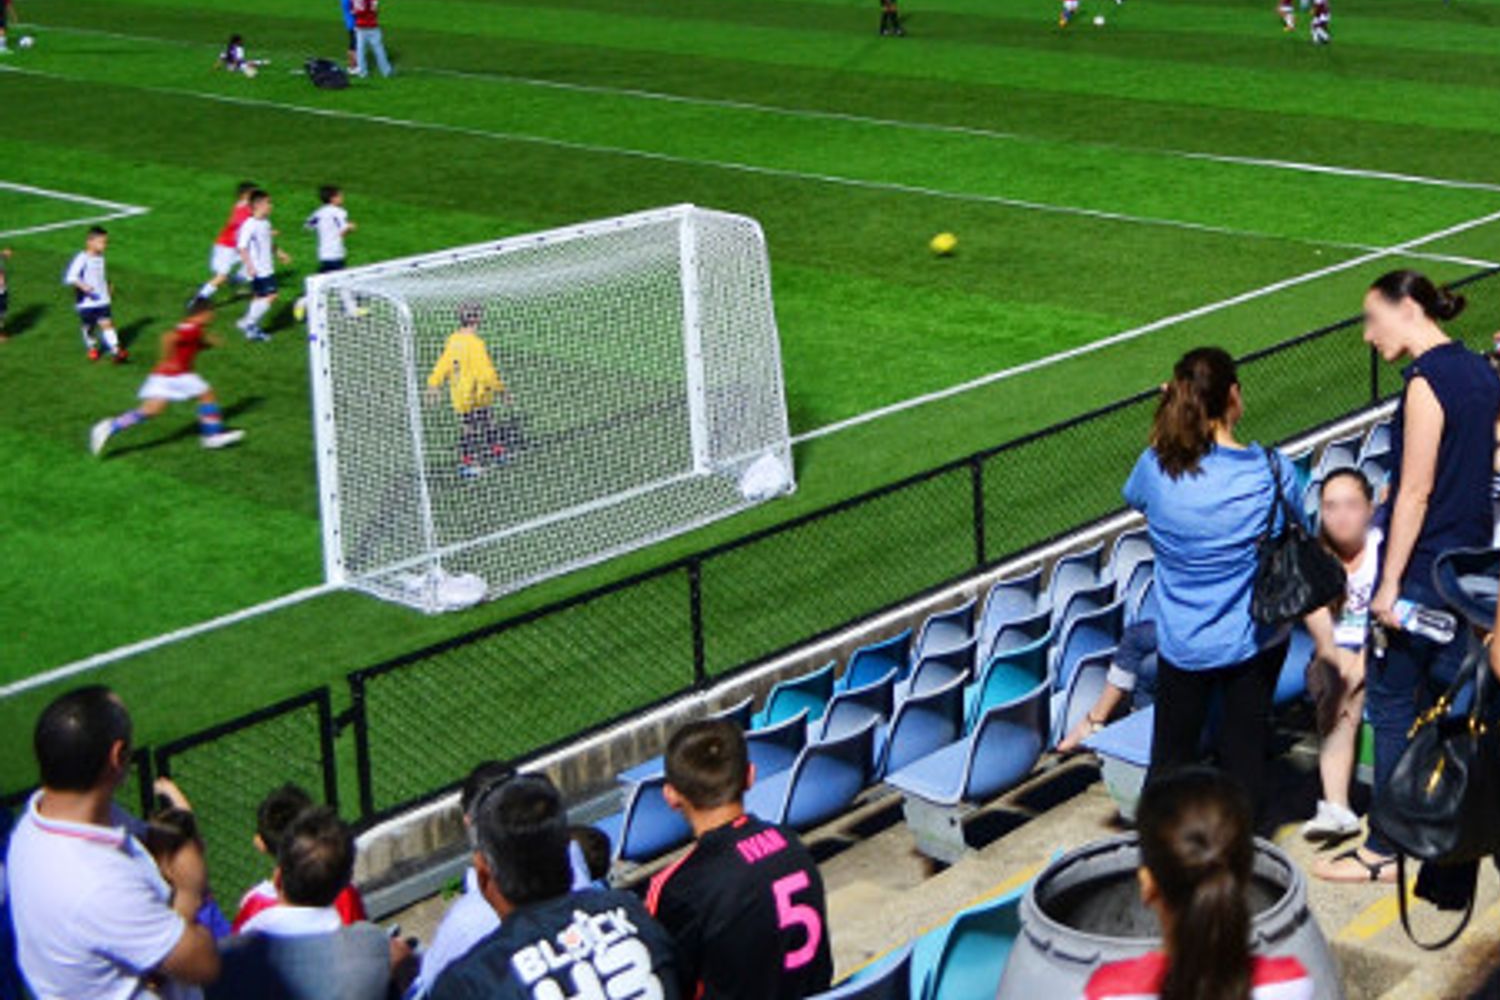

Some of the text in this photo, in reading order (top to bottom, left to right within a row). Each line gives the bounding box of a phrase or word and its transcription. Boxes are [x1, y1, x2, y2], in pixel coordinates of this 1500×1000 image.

[736, 827, 788, 864] IVAN
[511, 906, 639, 985] BLOCK
[772, 869, 822, 970] 5
